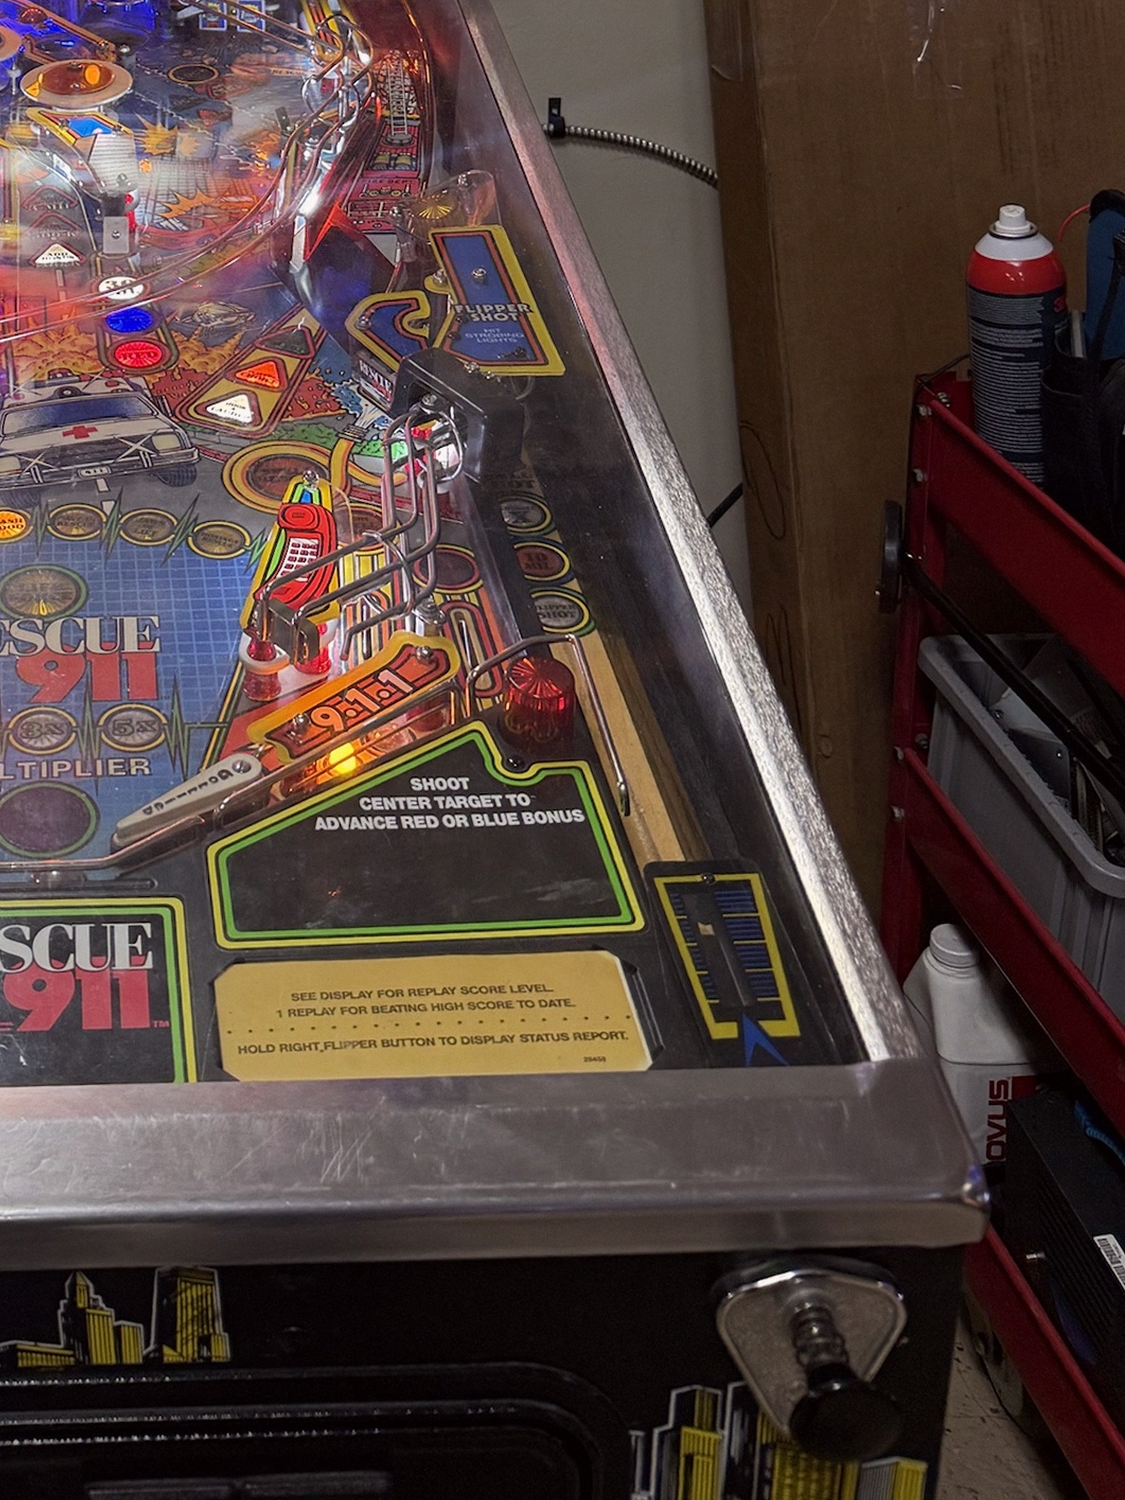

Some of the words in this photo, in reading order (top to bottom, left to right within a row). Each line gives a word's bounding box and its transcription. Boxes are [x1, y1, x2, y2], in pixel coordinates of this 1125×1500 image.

[454, 303, 533, 313] FLIPPER
[471, 312, 520, 322] SHOT
[16, 643, 158, 703] 911
[411, 777, 470, 791] SHOOT
[359, 796, 430, 811] CENTER
[433, 795, 503, 809] TARGET
[508, 794, 531, 806] TO
[315, 816, 398, 831] ADVANCE
[402, 815, 441, 829] RED
[446, 814, 470, 828] OR
[474, 812, 521, 827] BLUE
[525, 809, 585, 824] BONUS
[3, 956, 151, 1032] 911
[291, 992, 316, 1001] SEE
[320, 991, 373, 1000] DISPLAY
[377, 989, 404, 998] FOR
[408, 987, 456, 997] REPLAY
[460, 985, 506, 995] SCORE
[510, 984, 554, 993] LEVEL.
[288, 1007, 337, 1017] REPLAY
[340, 1006, 367, 1015] FOR
[371, 1004, 427, 1014] BEATING
[432, 1003, 465, 1011] HIGH
[467, 1001, 514, 1010] SCORE
[519, 1000, 535, 1008] TO
[539, 998, 576, 1007] DATE.
[238, 1045, 275, 1054] HOLD
[279, 1042, 320, 1052] RIGHT
[324, 1040, 377, 1050] FLIPPER
[381, 1037, 435, 1048] BUTTON
[438, 1036, 457, 1045] TO
[460, 1034, 515, 1045] DISPLAY
[519, 1033, 570, 1043] STATUS
[573, 1031, 629, 1041] REPORT.
